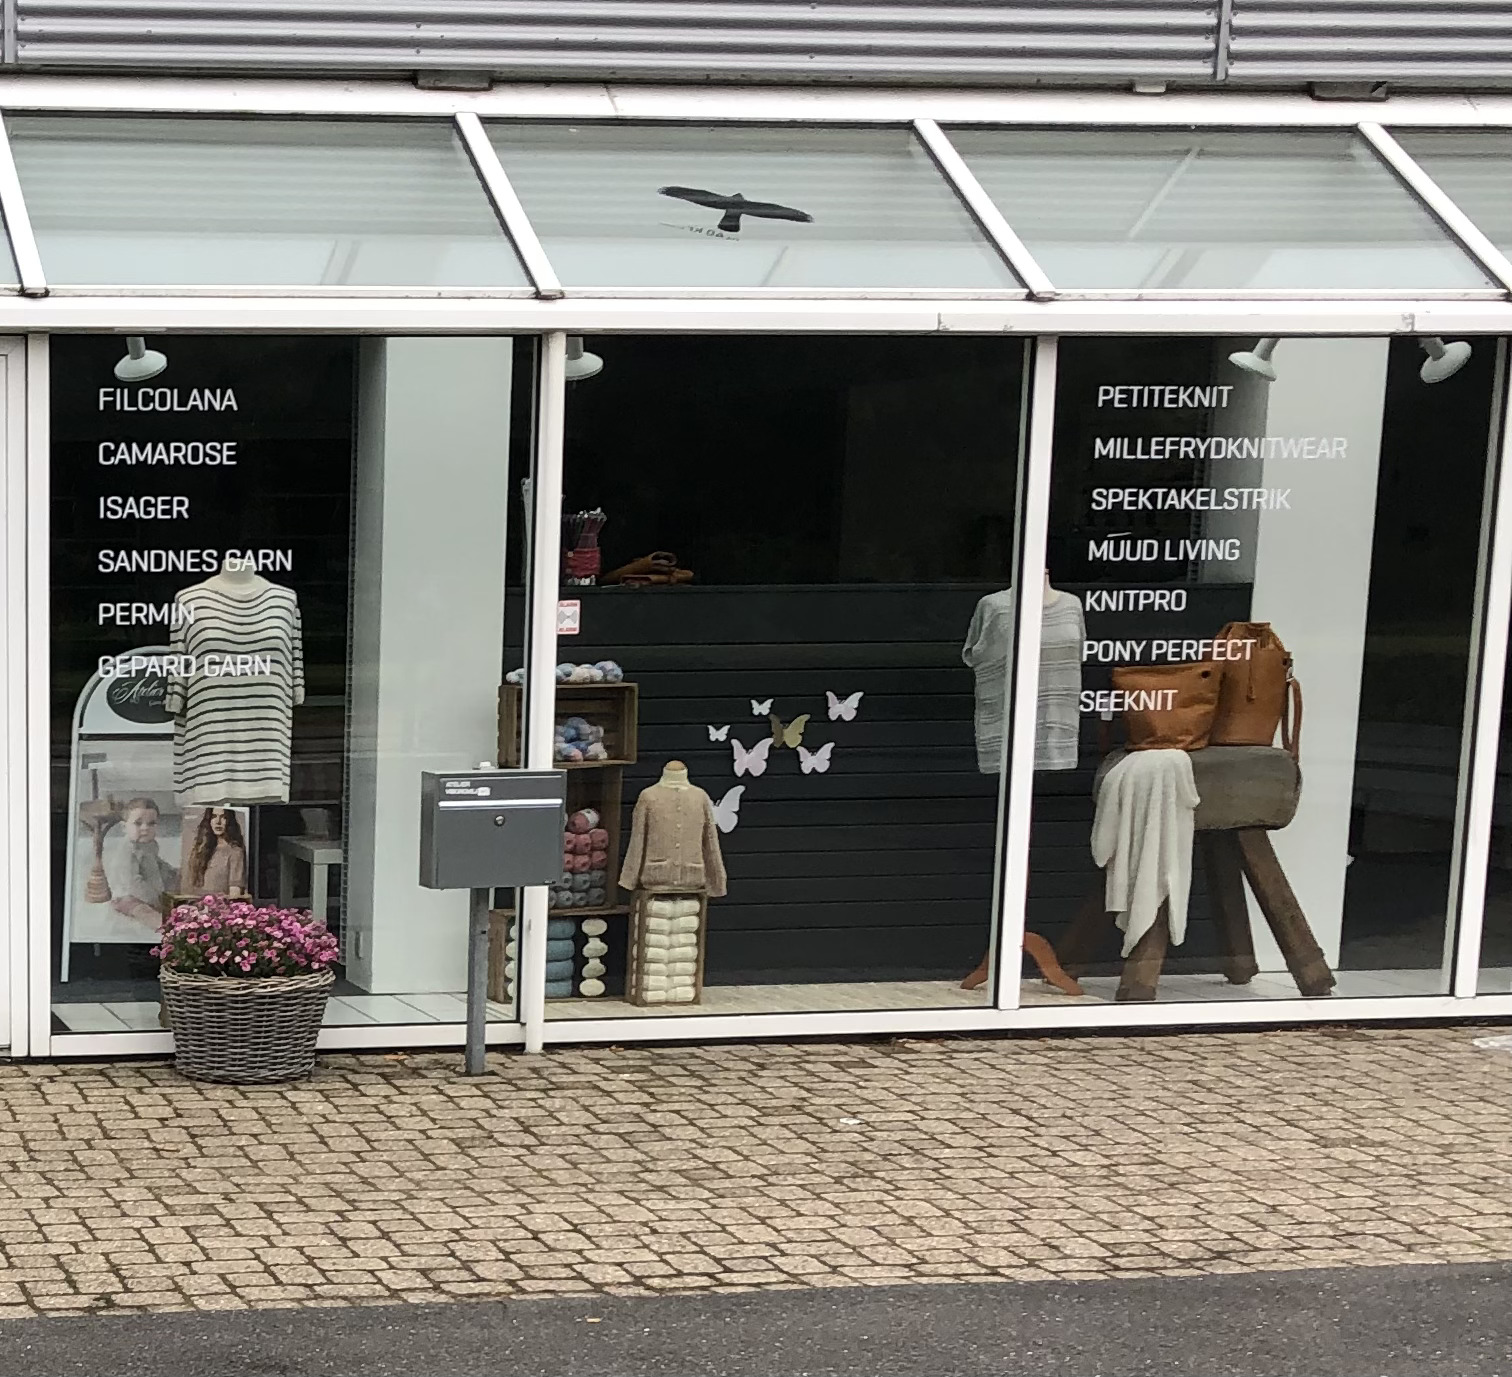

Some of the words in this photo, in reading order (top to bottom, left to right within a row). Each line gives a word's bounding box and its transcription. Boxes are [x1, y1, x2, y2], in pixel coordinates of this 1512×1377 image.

[98, 387, 239, 411] FILCOLANA
[1096, 385, 1234, 408] PETITEKNIT
[98, 442, 238, 466] CAMAROSE
[1093, 437, 1348, 460] MILLEFRYDKNITWEAR
[98, 495, 190, 520] ISAGER
[1090, 487, 1292, 511] SPEKTAKELSTRIK
[97, 549, 219, 573] SANDNES
[224, 549, 293, 573] GARN
[1087, 539, 1159, 561] MUUD
[1163, 538, 1241, 561] LIVING
[1084, 589, 1188, 612] KNITPRO
[98, 602, 195, 626] PERMIN
[1081, 640, 1146, 663] PONY
[1150, 639, 1257, 662] PERFECT
[97, 655, 197, 678] GEPARD
[203, 654, 272, 677] GARN
[1078, 689, 1179, 713] SEEKNIT
